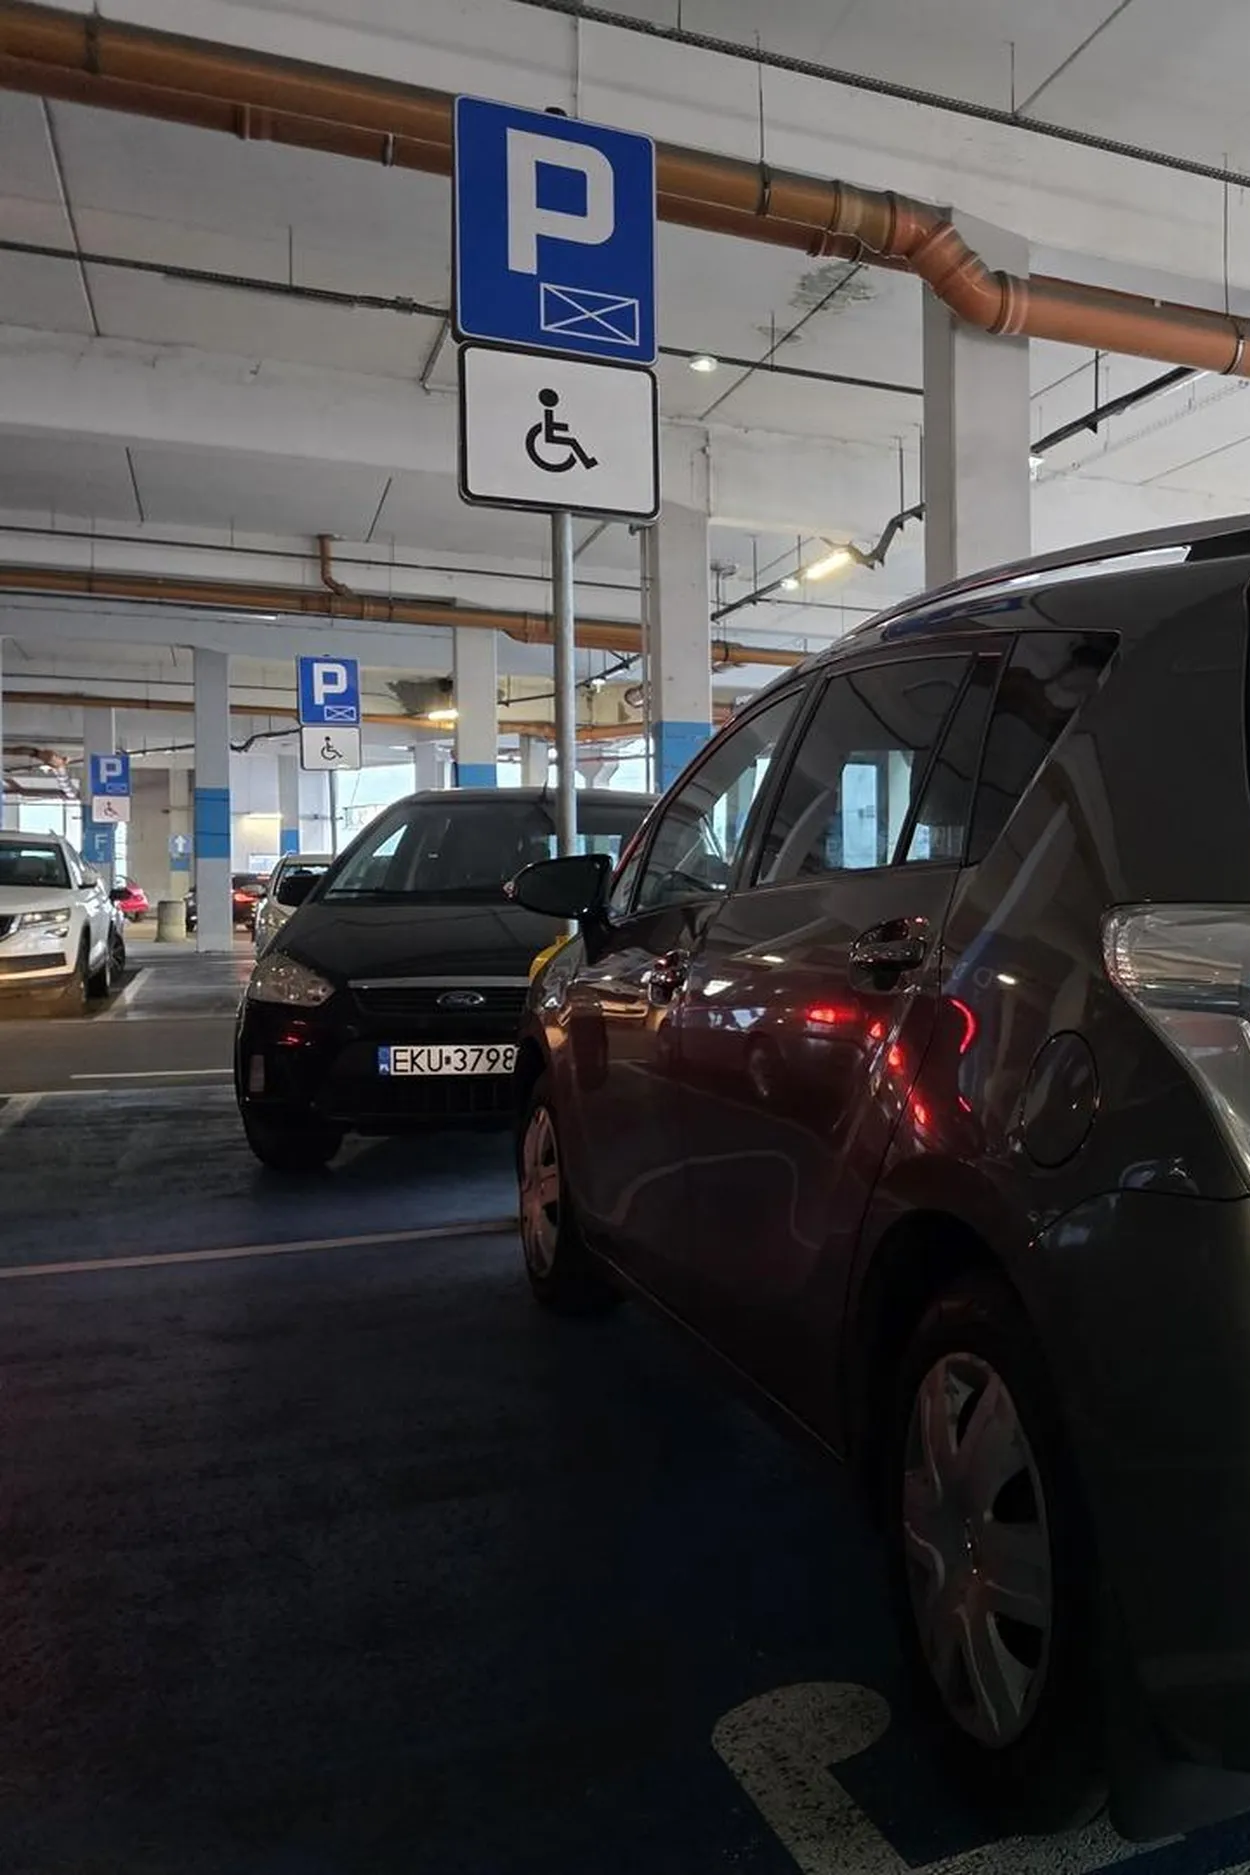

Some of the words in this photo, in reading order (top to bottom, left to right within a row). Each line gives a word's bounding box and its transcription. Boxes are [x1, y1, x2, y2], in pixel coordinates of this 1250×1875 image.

[506, 126, 615, 275] P
[313, 662, 347, 705] P
[100, 758, 122, 784] P
[393, 1048, 443, 1073] EKU
[454, 1047, 515, 1072] 3798
